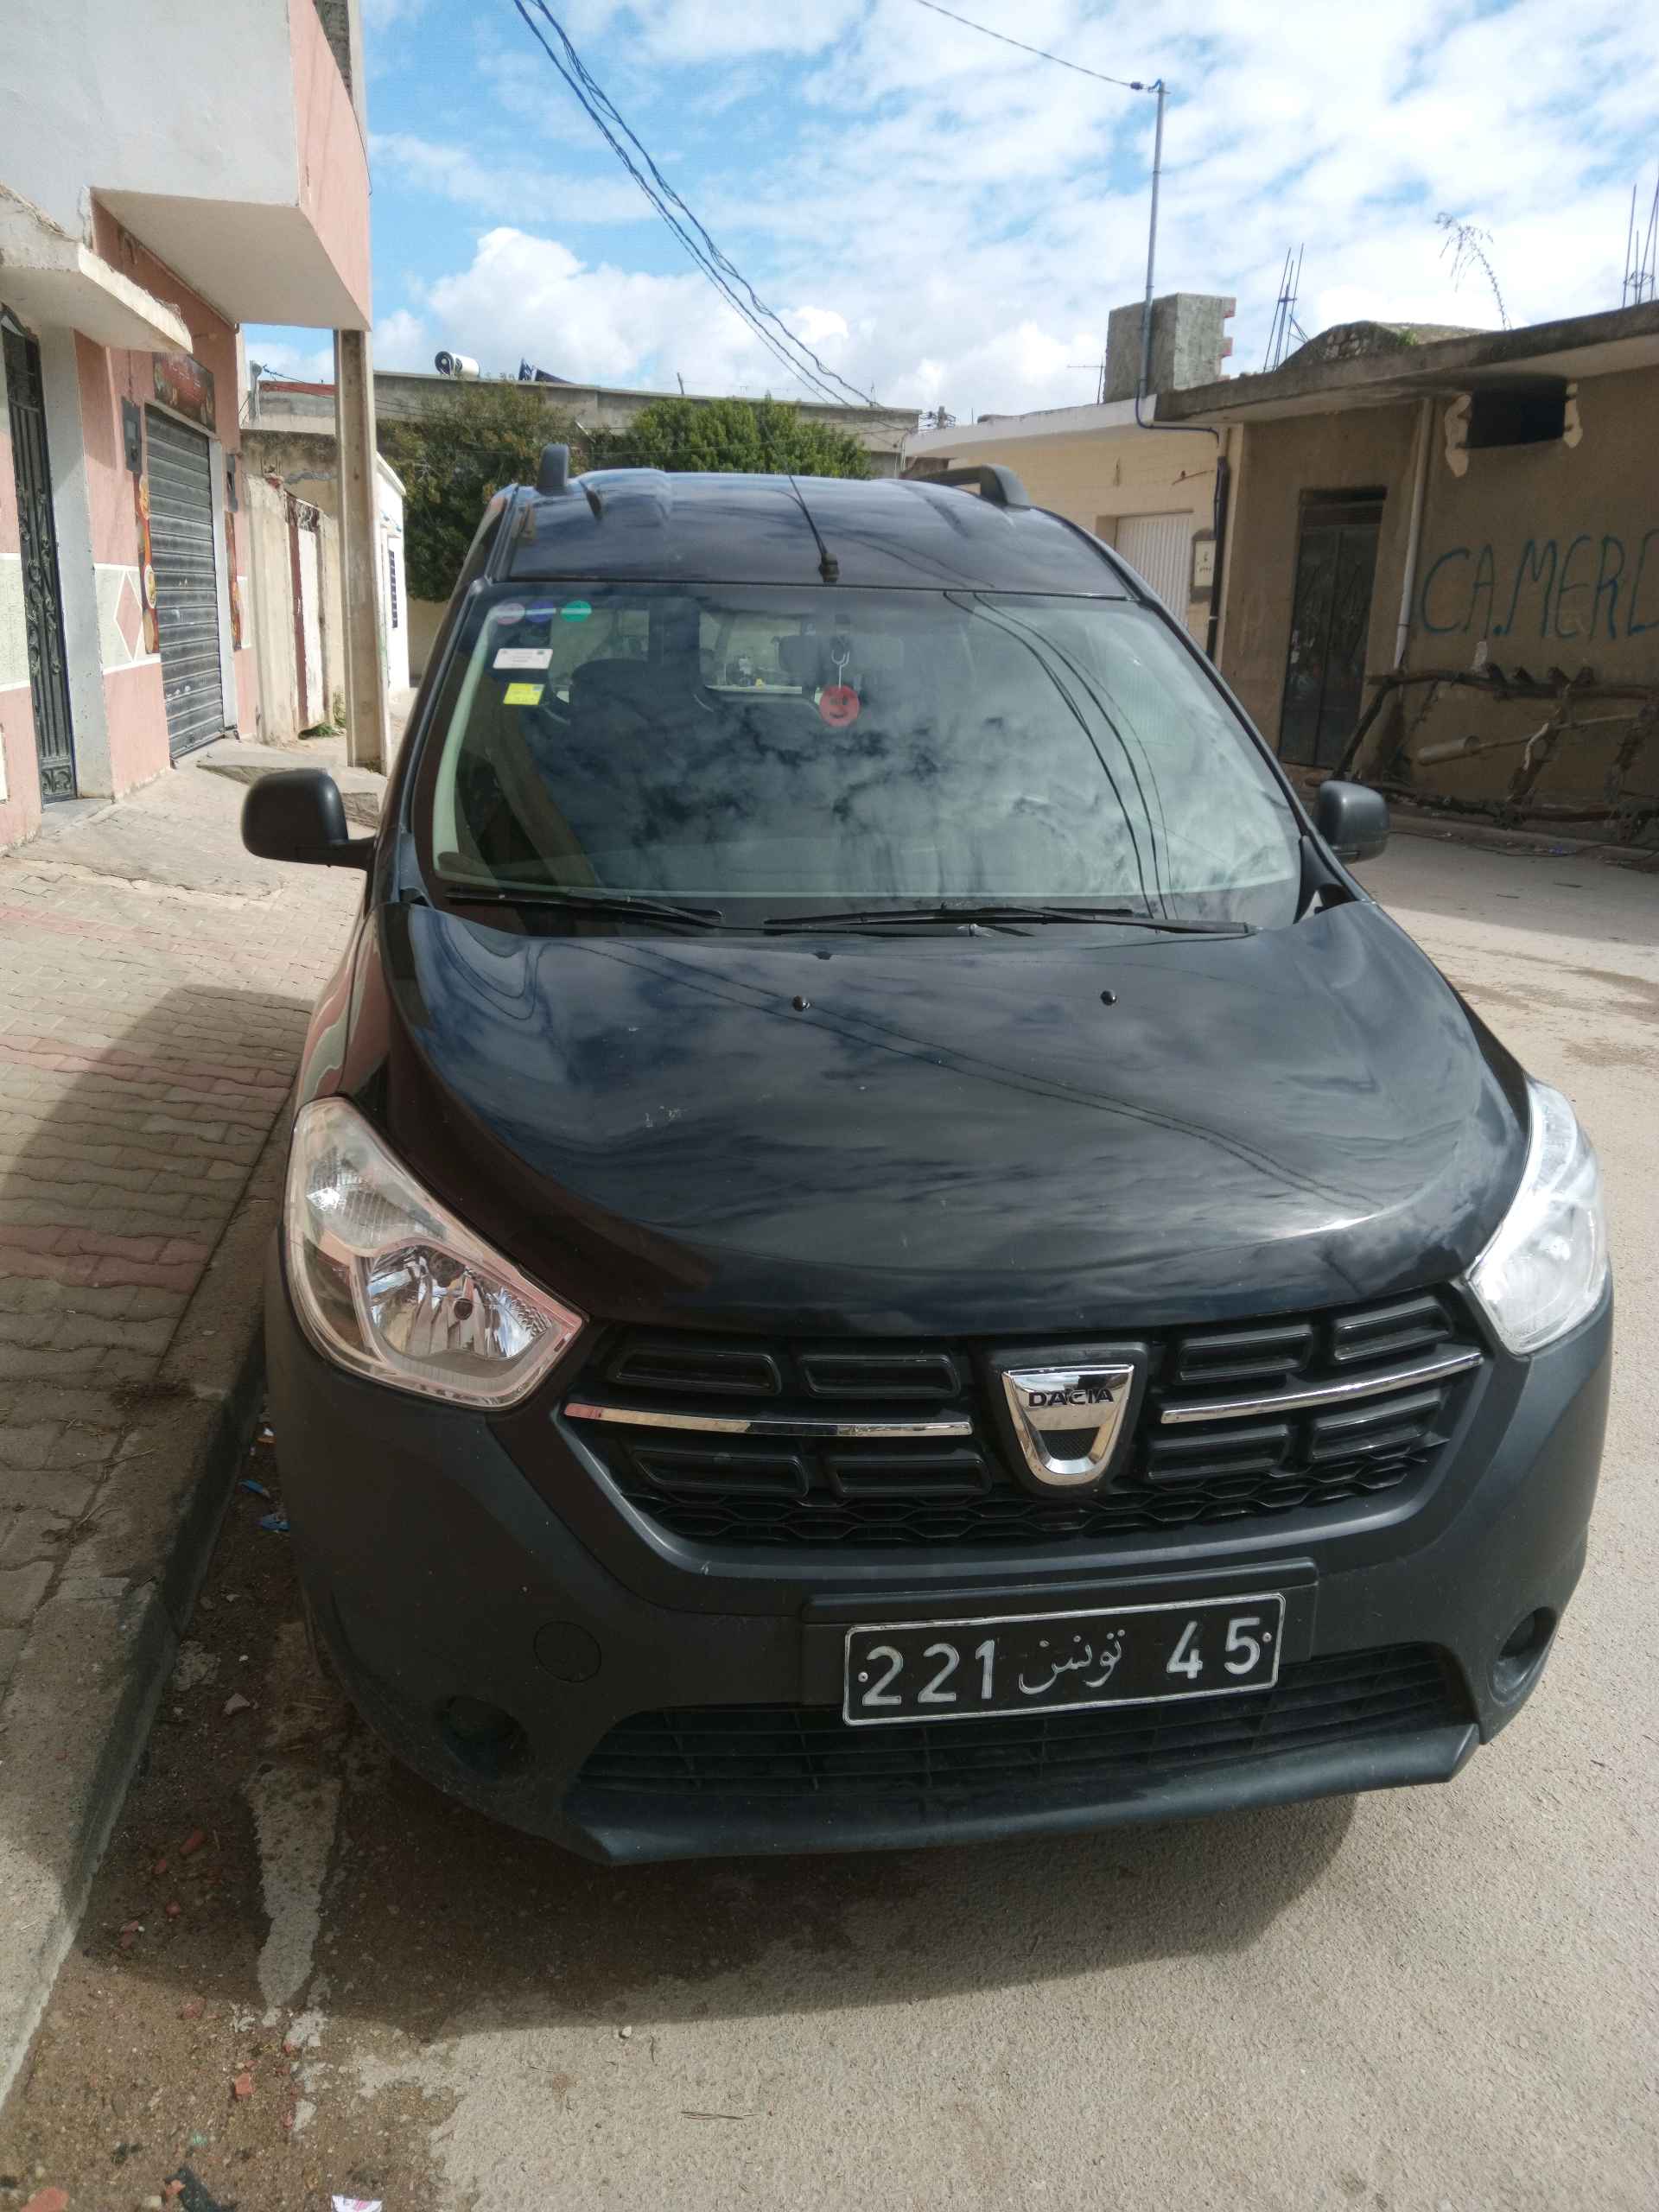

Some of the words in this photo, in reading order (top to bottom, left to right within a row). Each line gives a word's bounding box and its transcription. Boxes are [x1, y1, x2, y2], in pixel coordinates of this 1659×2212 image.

[1028, 1389, 1114, 1408] DACIA
[862, 1640, 995, 1706] 221
[1019, 1629, 1126, 1695] تونس
[1166, 1616, 1261, 1681] 45
